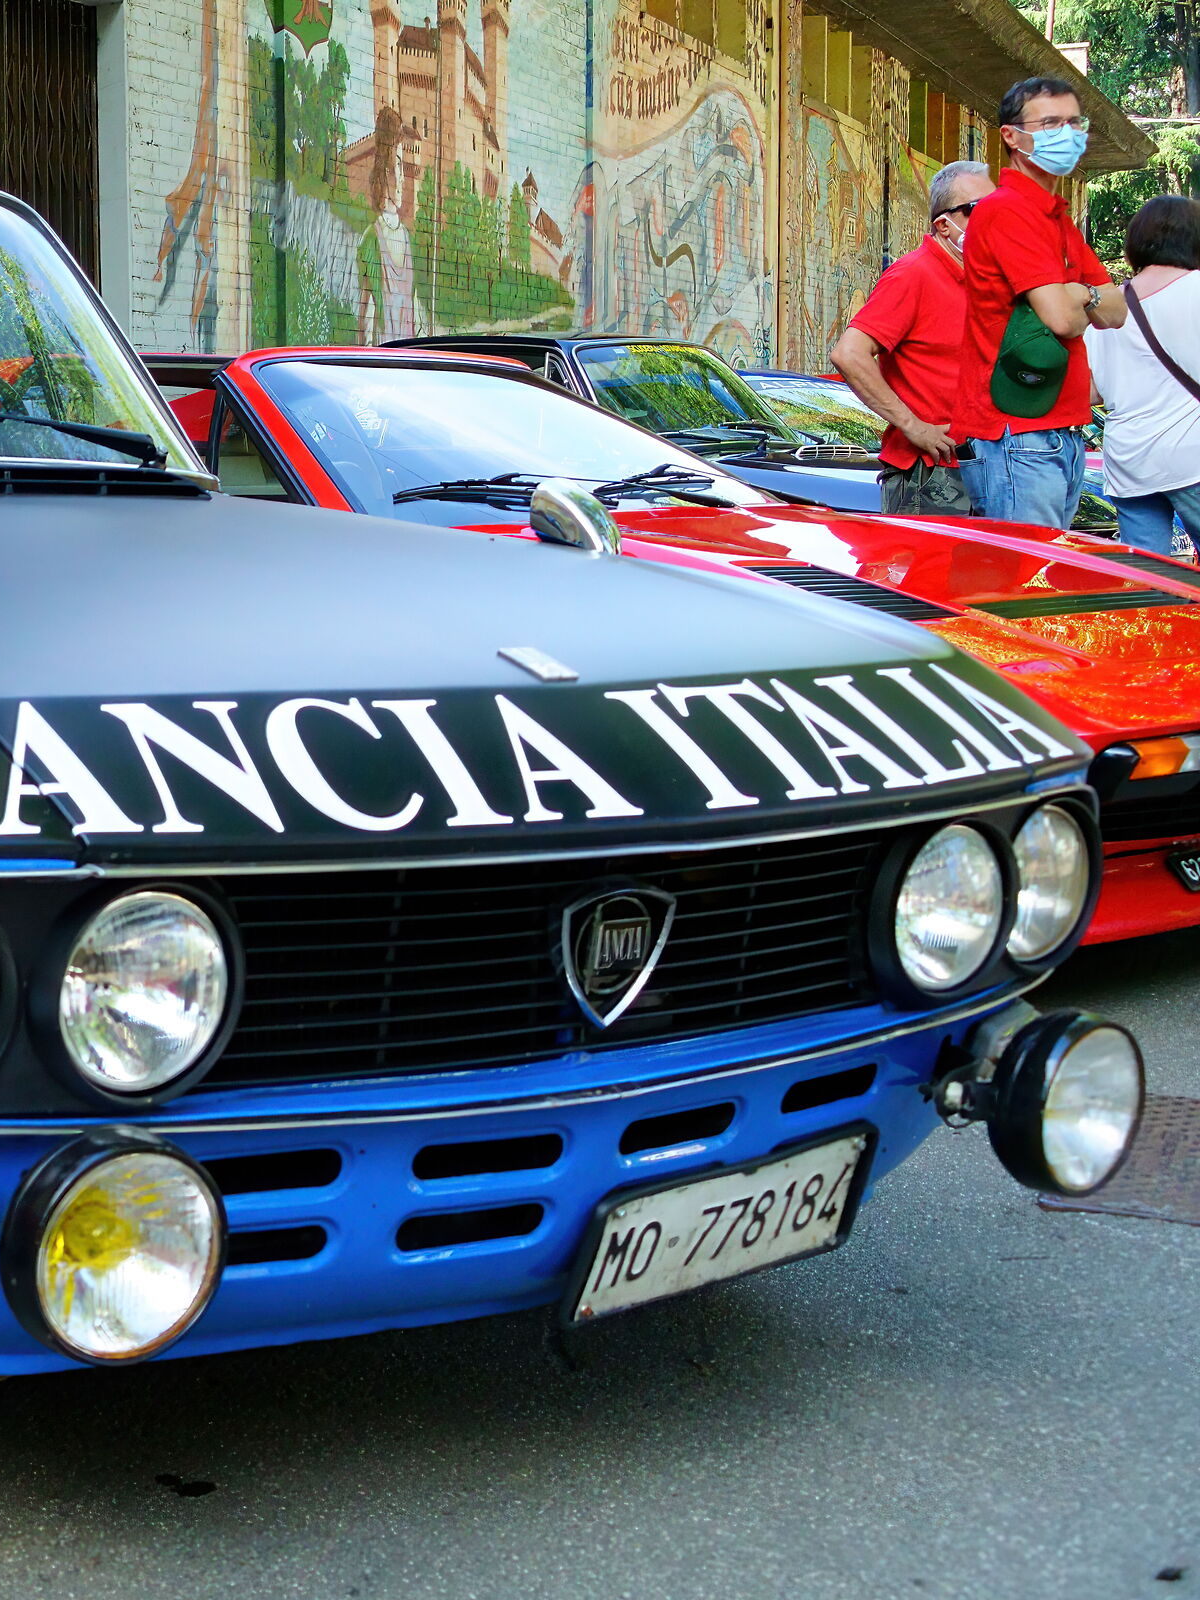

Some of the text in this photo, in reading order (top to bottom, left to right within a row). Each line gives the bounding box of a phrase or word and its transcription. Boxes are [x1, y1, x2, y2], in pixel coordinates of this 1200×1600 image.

[603, 663, 1073, 809] ITALIA
[592, 1163, 854, 1293] MO 778184
